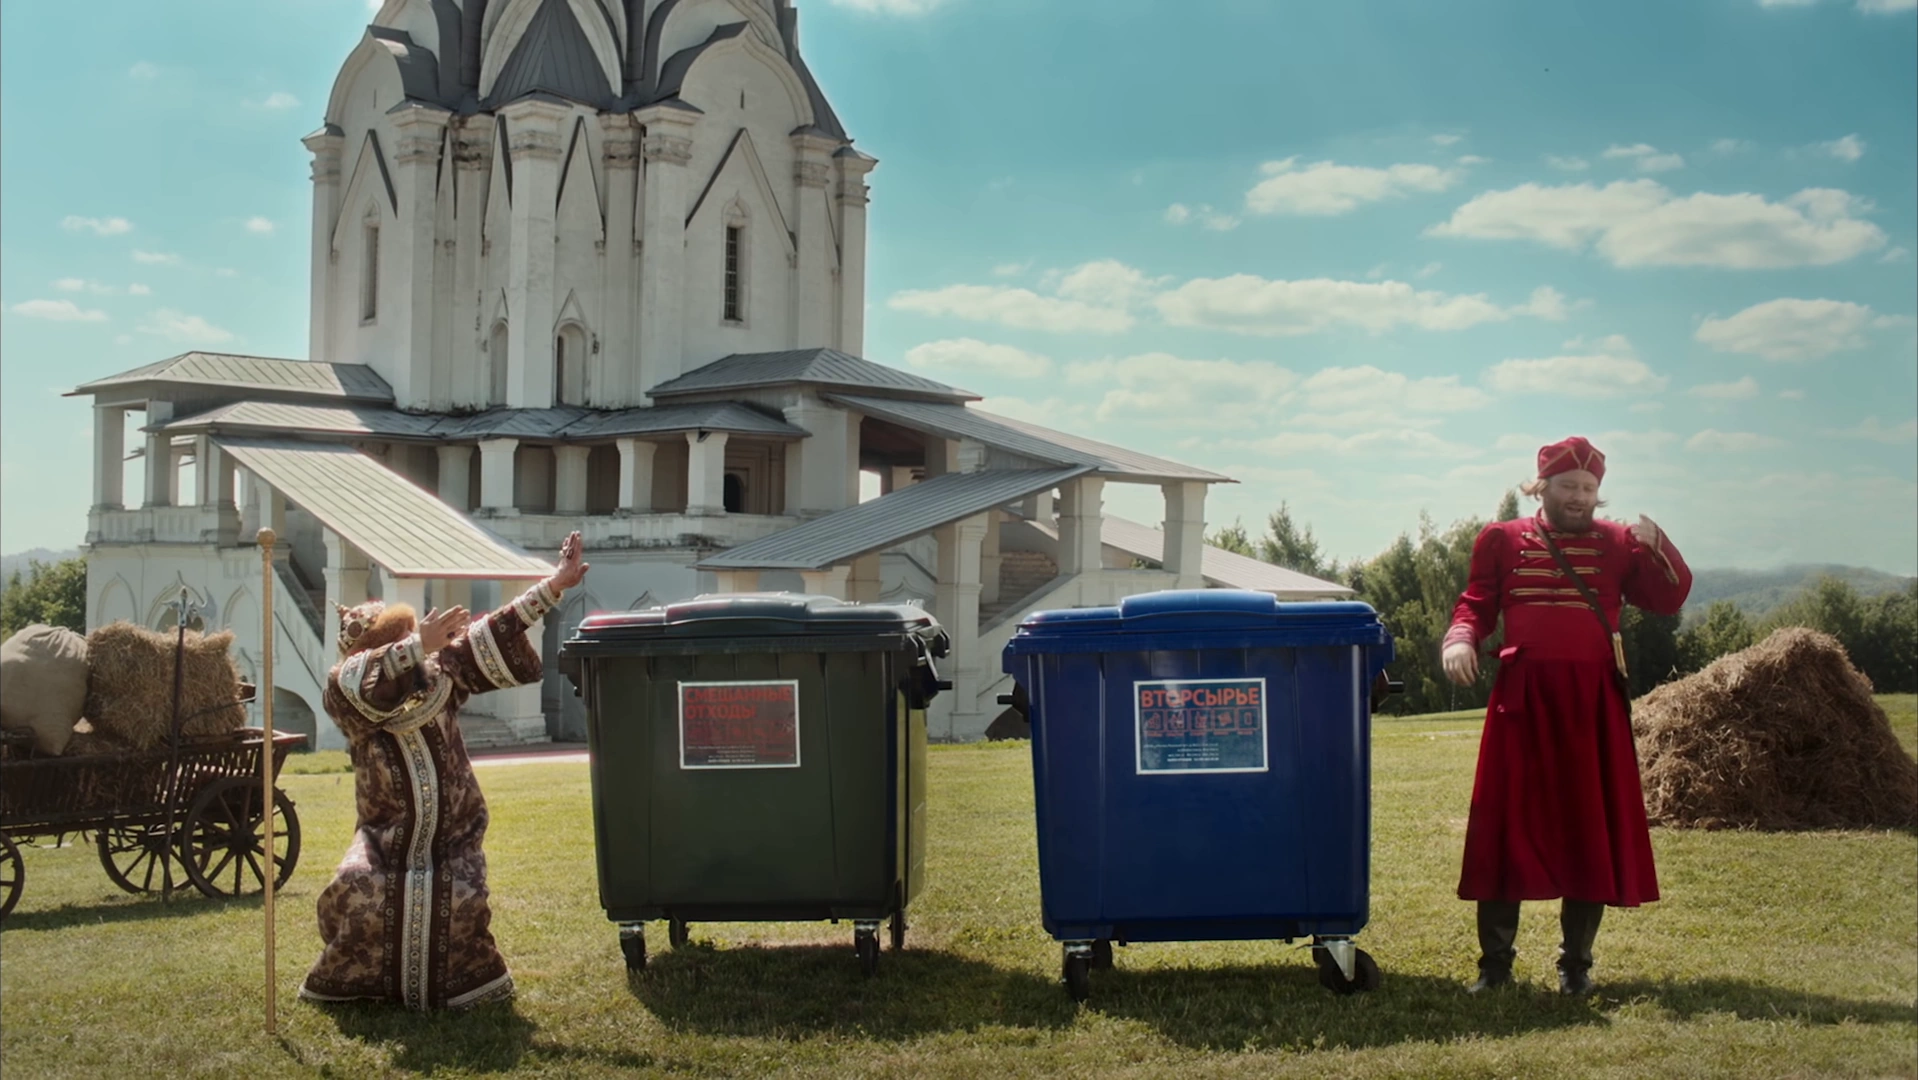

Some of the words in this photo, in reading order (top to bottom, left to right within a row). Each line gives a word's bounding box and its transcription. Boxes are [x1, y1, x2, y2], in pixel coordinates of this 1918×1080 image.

[686, 687, 793, 702] СМЕШАННЫЕ
[1141, 687, 1259, 707] ВТОРСЫРЬЕ
[685, 704, 756, 719] ОТХОДЫ
